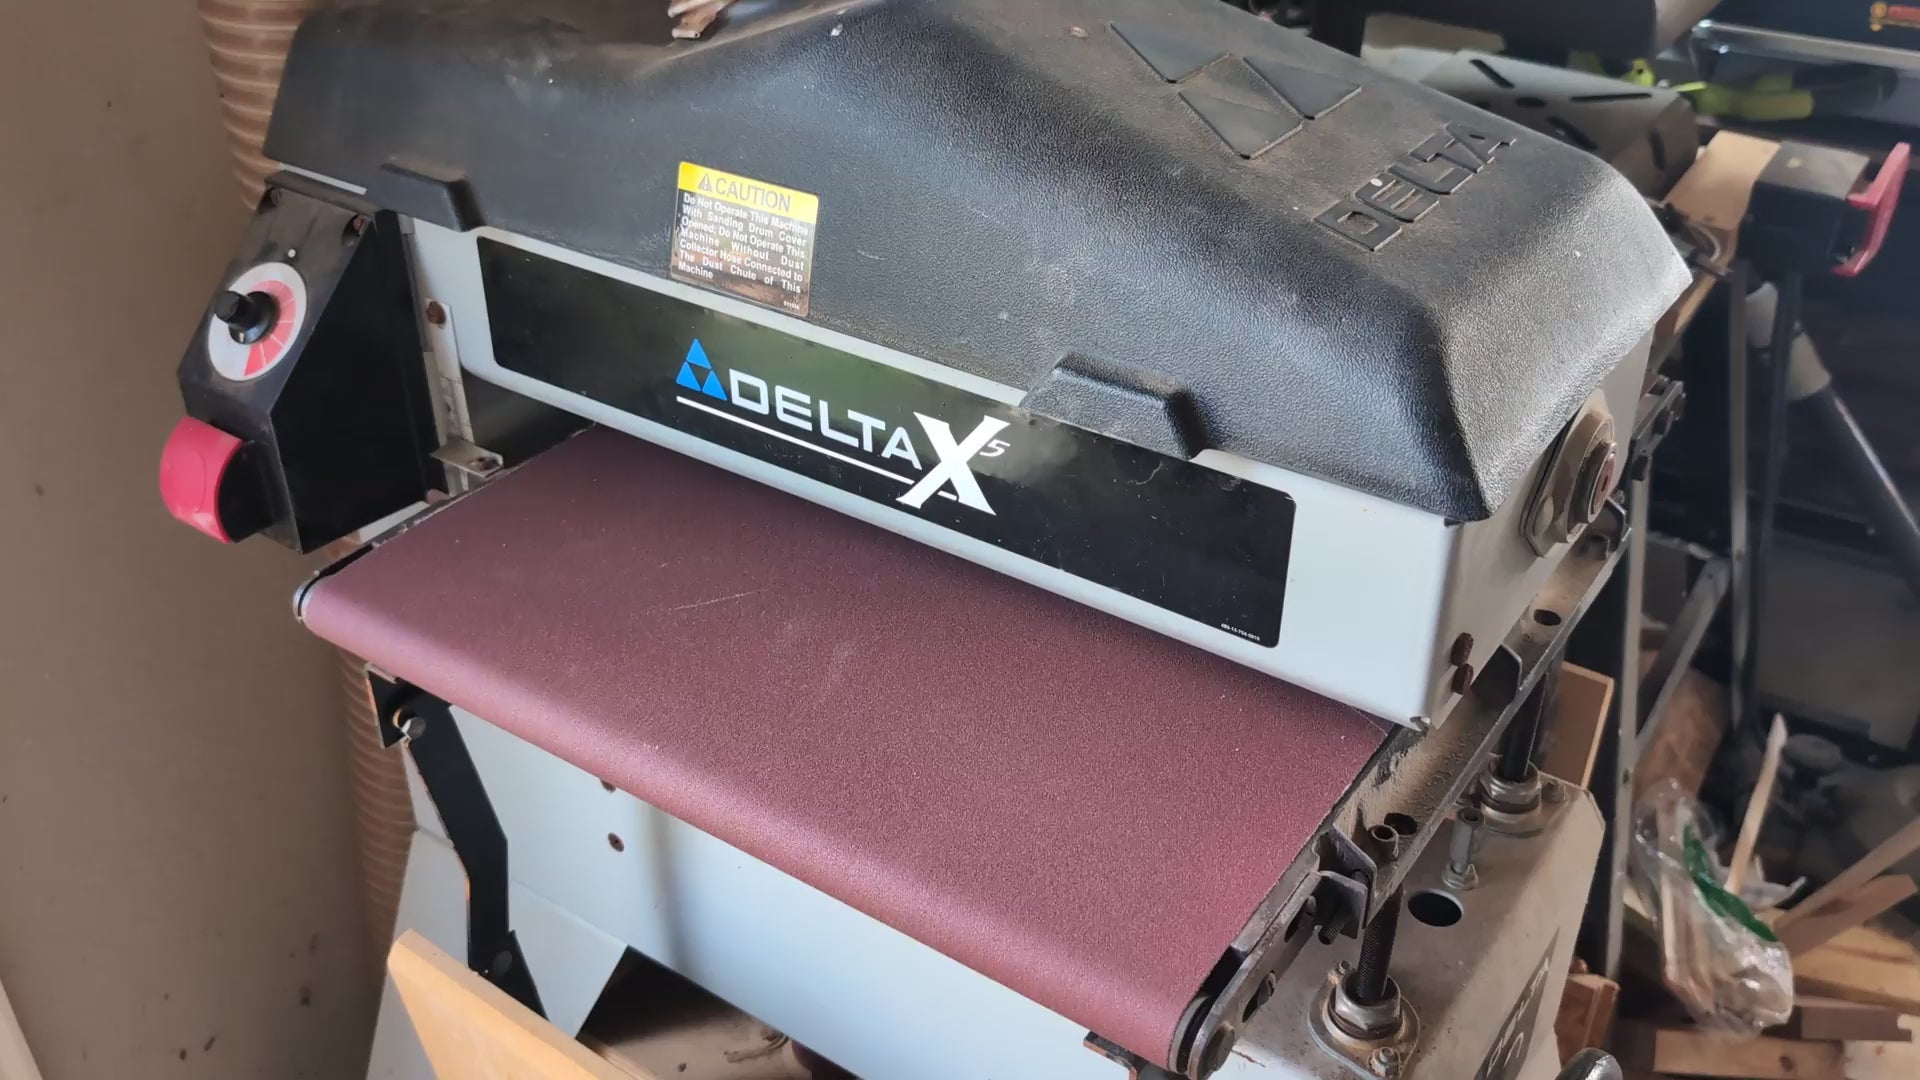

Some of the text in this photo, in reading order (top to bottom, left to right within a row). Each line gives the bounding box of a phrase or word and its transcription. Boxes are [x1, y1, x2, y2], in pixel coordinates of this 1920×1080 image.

[715, 177, 791, 212] CAUTION
[1312, 121, 1517, 253] DELTA
[682, 205, 807, 246] With Sanding Drum Cover
[683, 193, 809, 235] Do Not Operate This Machine
[680, 239, 803, 282] Collector Hose Connected to
[681, 228, 805, 270] Machine Without Dust
[719, 226, 731, 238] Do
[733, 229, 748, 243] Not
[750, 235, 784, 253] Operate
[786, 245, 805, 258] This
[678, 261, 713, 279] Machine
[679, 250, 801, 293] The Dust Chute of This
[729, 368, 923, 471] DELTA
